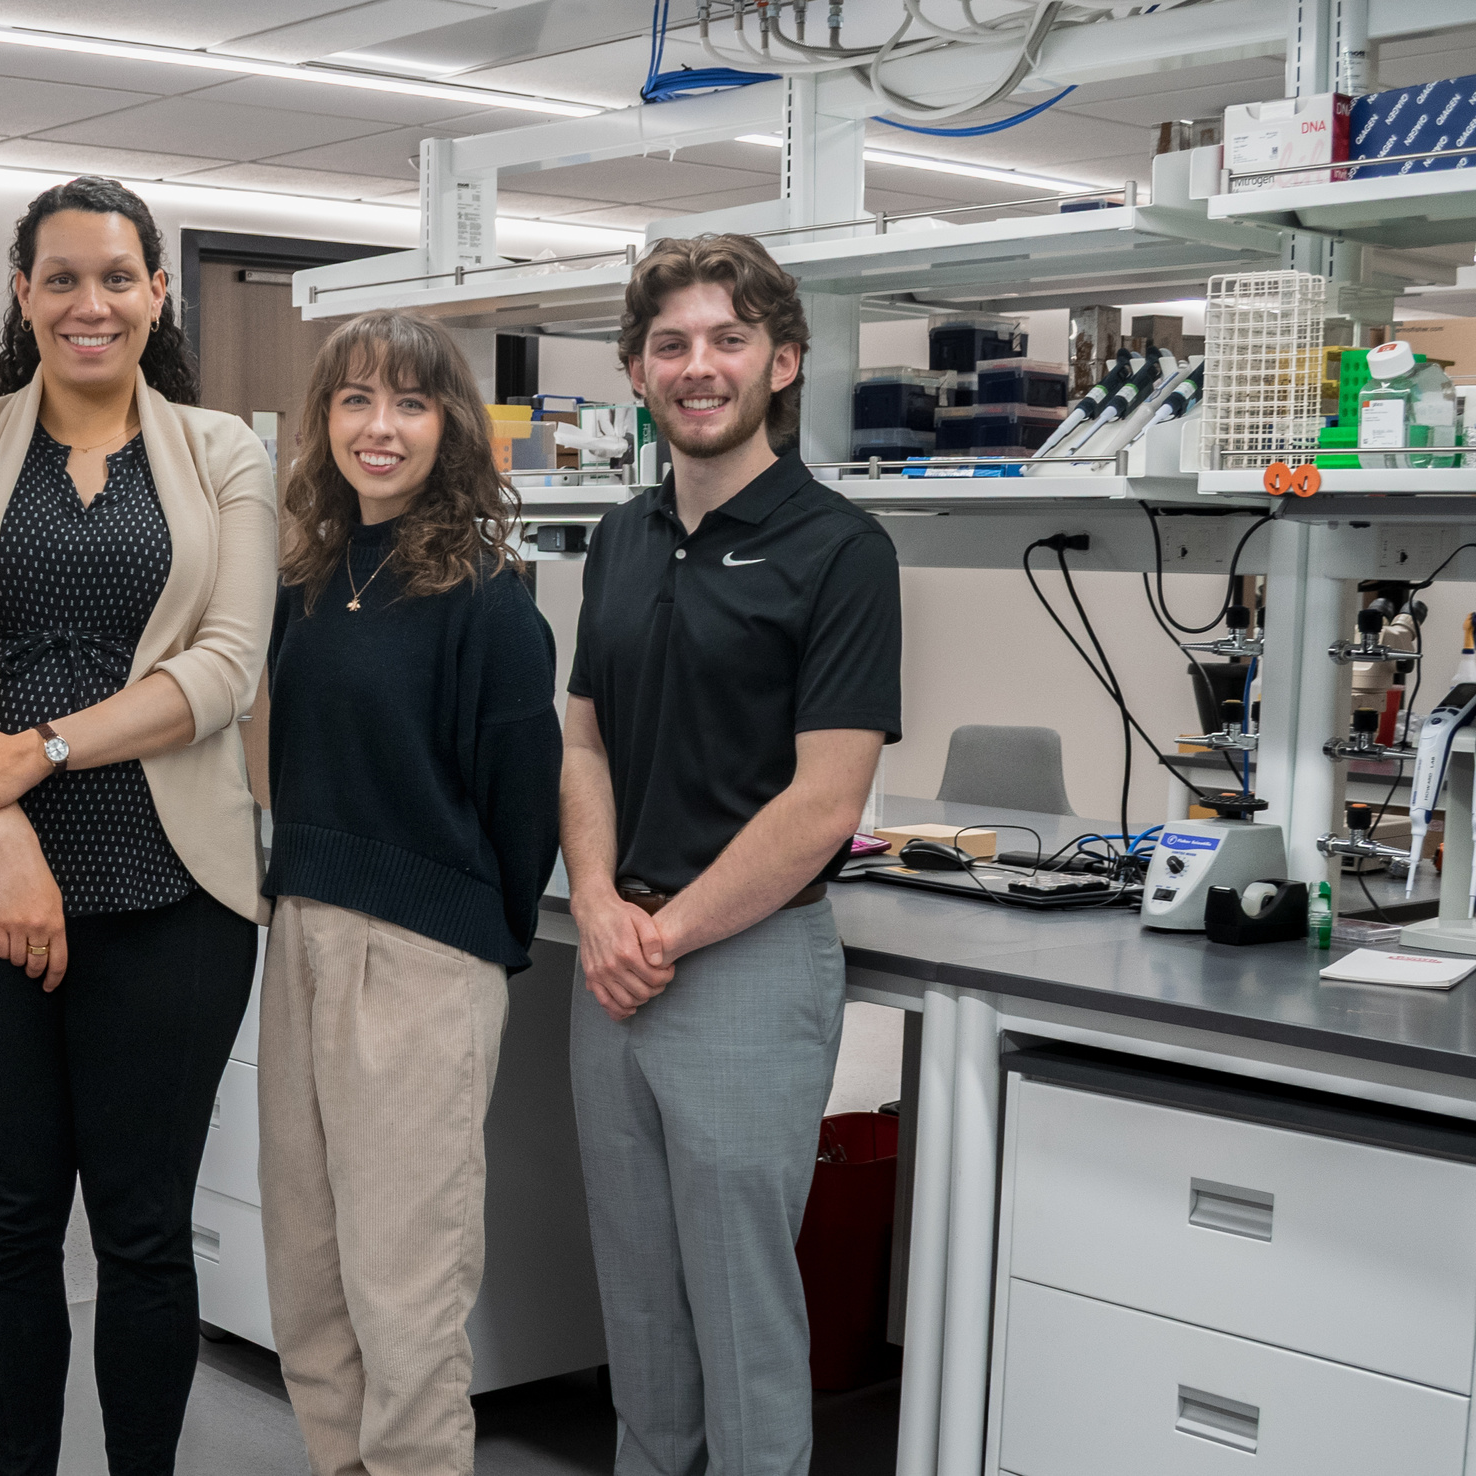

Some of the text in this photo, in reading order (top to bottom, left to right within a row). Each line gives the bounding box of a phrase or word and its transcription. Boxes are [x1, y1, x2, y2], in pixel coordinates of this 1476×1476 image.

[1416, 81, 1438, 104] QIAG
[1385, 93, 1409, 125] QIAGEN
[1436, 93, 1461, 125] QIAGEN
[1301, 121, 1326, 134] DNA
[1355, 114, 1378, 145] QIAGEN
[1403, 114, 1427, 146] QIAGEN
[1456, 116, 1476, 147] QIAGE
